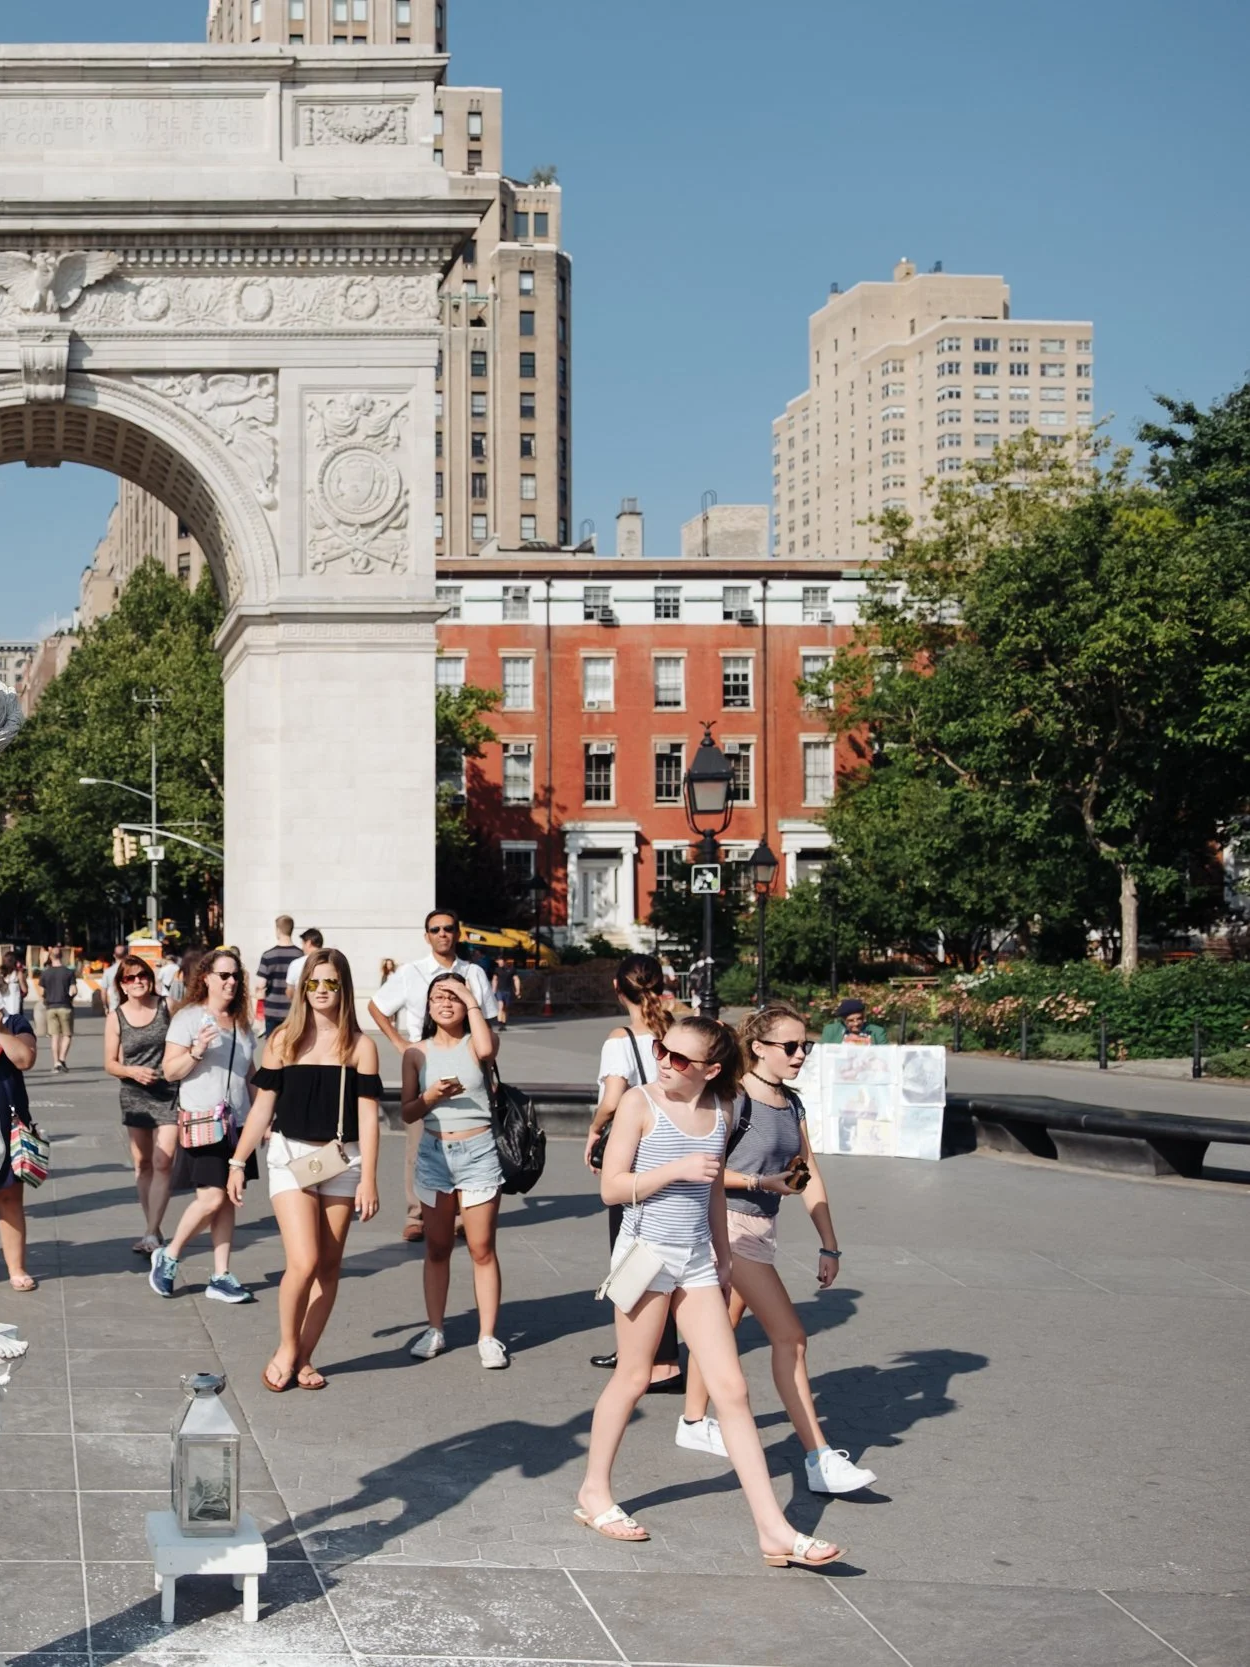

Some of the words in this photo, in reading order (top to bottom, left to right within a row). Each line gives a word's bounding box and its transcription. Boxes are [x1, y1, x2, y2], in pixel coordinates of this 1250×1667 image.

[74, 102, 99, 115] TO
[104, 102, 162, 115] WHICH
[170, 102, 204, 115] THE
[213, 102, 254, 115] WISE
[5, 117, 43, 131] CAN
[53, 117, 115, 131] REPAIR
[145, 117, 181, 131] THE
[190, 116, 254, 131] EVENT
[15, 132, 55, 146] GOD
[130, 131, 254, 146] WASHINGTON
